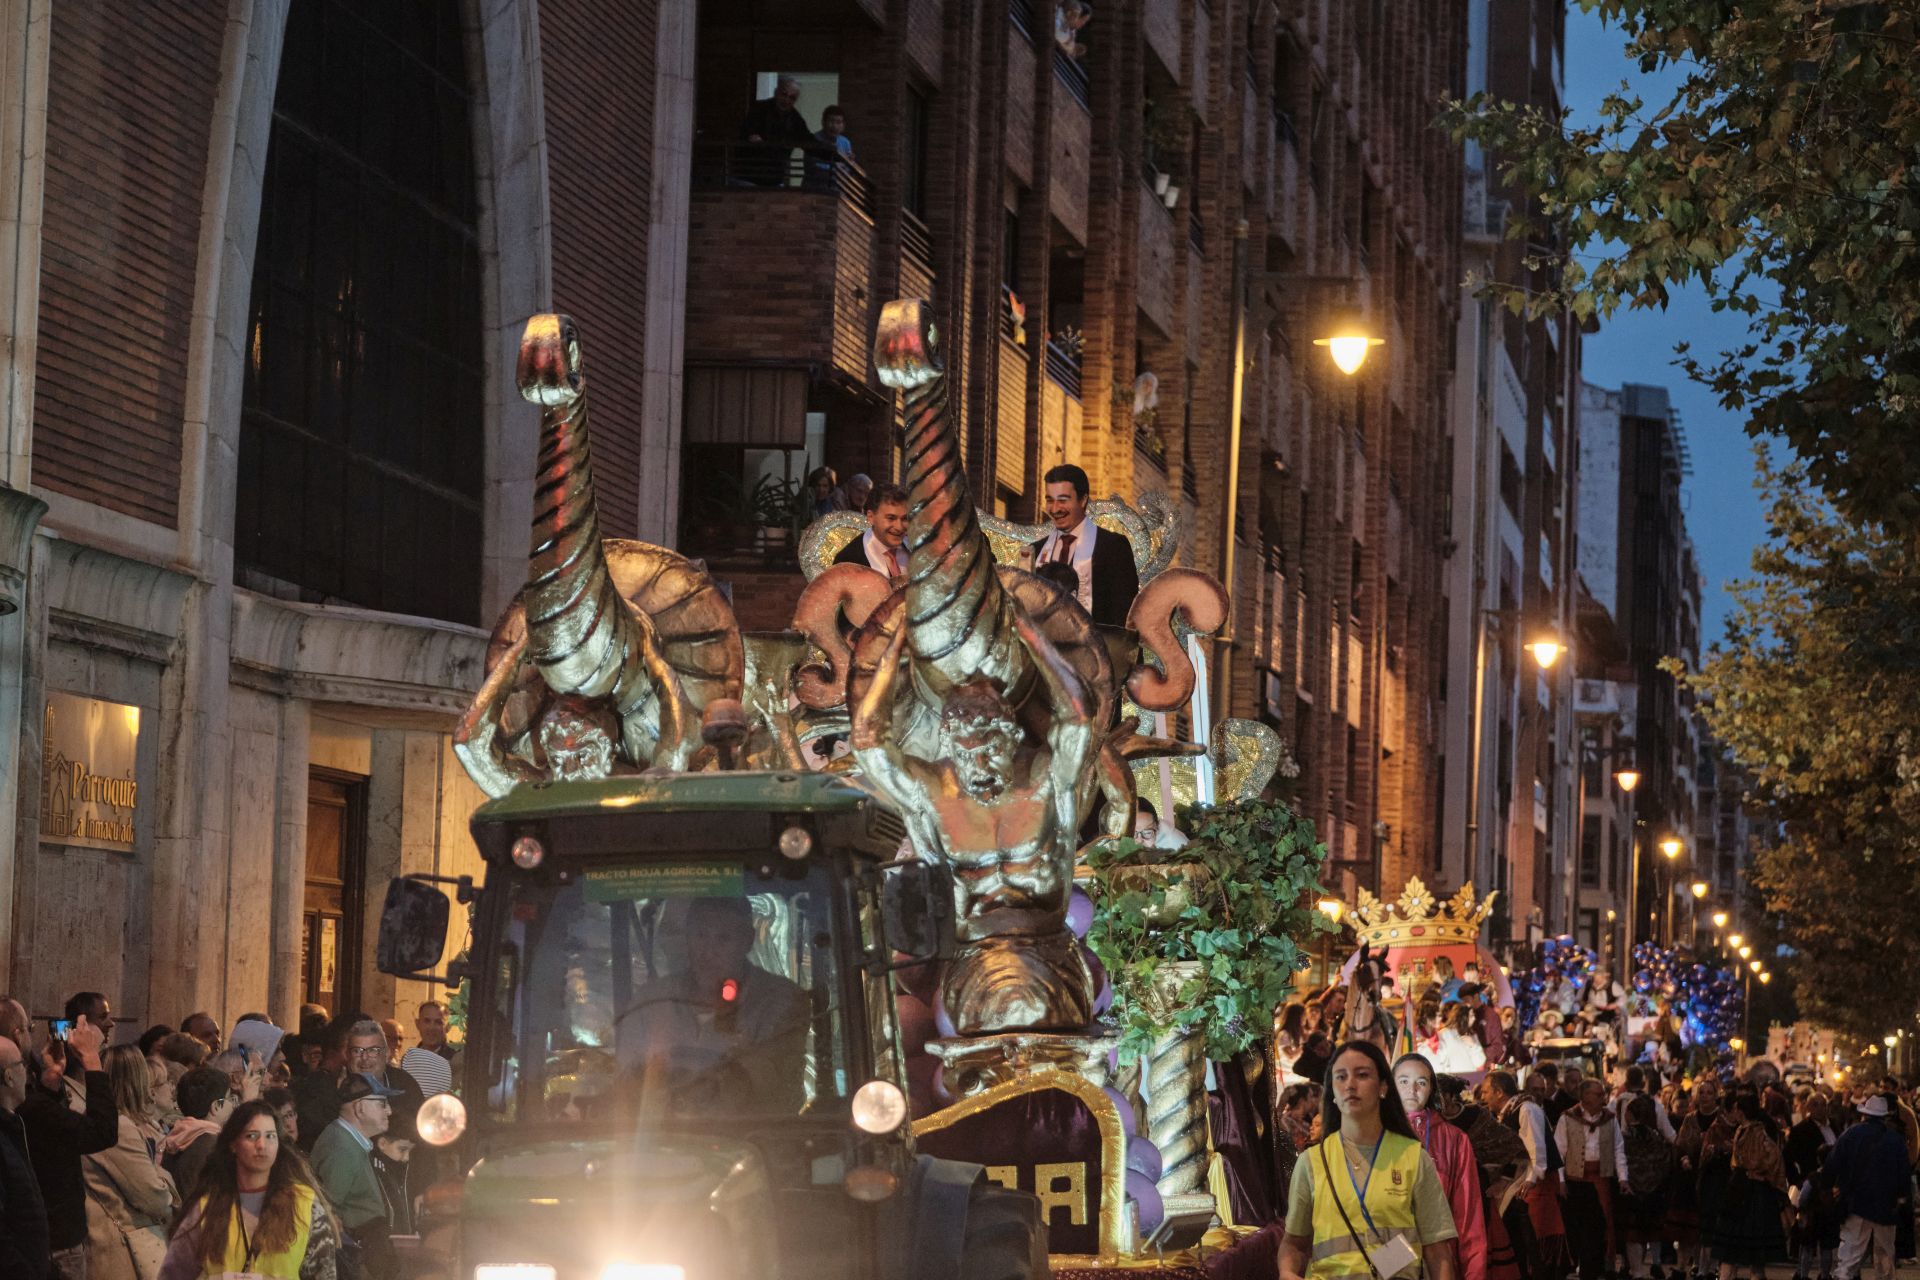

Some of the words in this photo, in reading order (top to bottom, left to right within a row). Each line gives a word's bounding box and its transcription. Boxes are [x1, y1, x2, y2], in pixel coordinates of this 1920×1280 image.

[72, 761, 137, 814] Parroquia
[70, 809, 84, 838] La
[85, 811, 135, 843] Inmaculada
[587, 870, 628, 881] TRACTO
[629, 868, 660, 878] RIOJA
